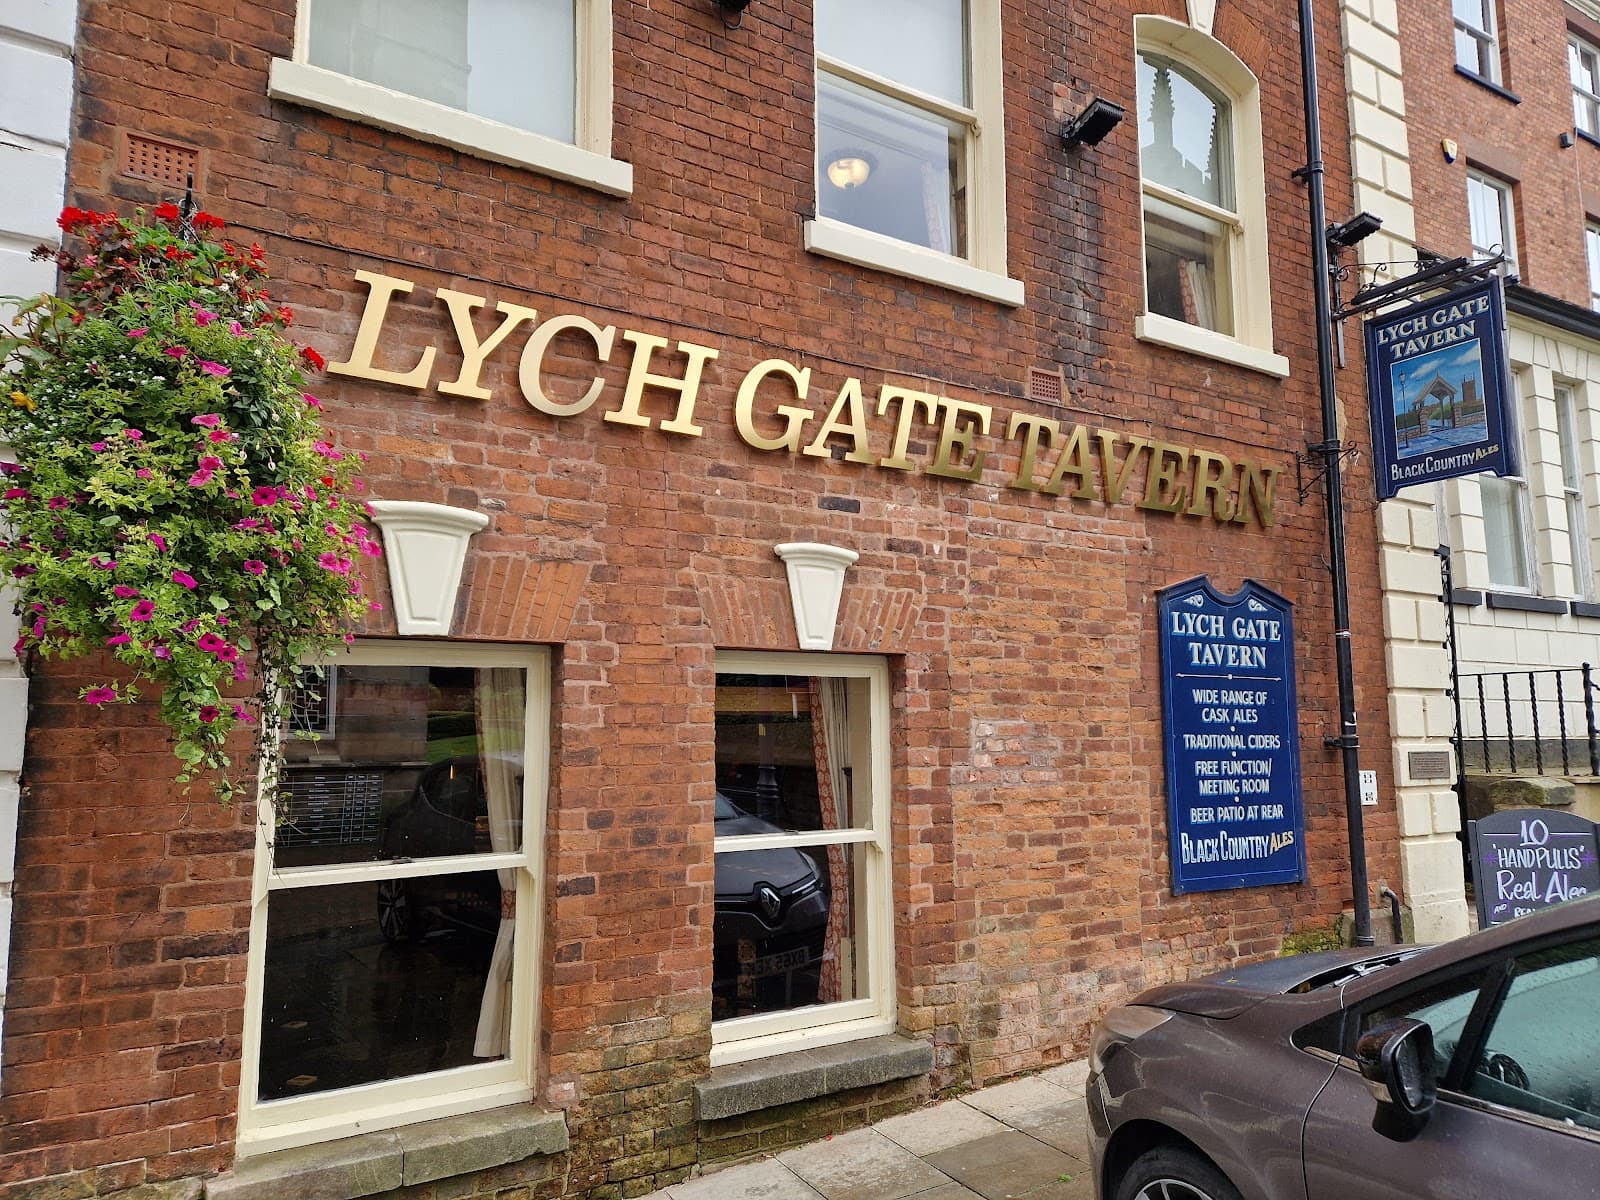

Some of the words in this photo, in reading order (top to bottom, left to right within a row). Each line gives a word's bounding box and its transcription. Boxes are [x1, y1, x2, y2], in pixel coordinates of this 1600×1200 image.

[1376, 317, 1428, 345] LYCH
[1431, 295, 1490, 327] GATE
[1390, 320, 1476, 359] TAVERN
[327, 269, 719, 437] LYCH
[734, 359, 993, 482] GATE
[1006, 410, 1282, 527] TAVERN
[1171, 612, 1225, 638] LYCH
[1231, 617, 1281, 642] GATE
[1189, 642, 1266, 669] TAVERN
[1192, 688, 1218, 705] WIDE
[1221, 689, 1255, 705] RANGE
[1255, 691, 1268, 705] OF
[1202, 708, 1230, 722] CASK
[1233, 709, 1258, 723] ALES
[1183, 734, 1246, 750] TRADITIONAL
[1248, 735, 1281, 750] CIDERS
[1195, 761, 1219, 776] FREE
[1221, 758, 1272, 776] FUNCTION/
[1199, 779, 1240, 796] MEETING
[1242, 779, 1270, 793] ROOM
[1190, 808, 1215, 824] BEER
[1217, 806, 1245, 822] PATIO
[1247, 806, 1259, 820] AT
[1261, 804, 1284, 819] REAR
[1520, 819, 1549, 846] 10
[1496, 870, 1541, 901] Real
